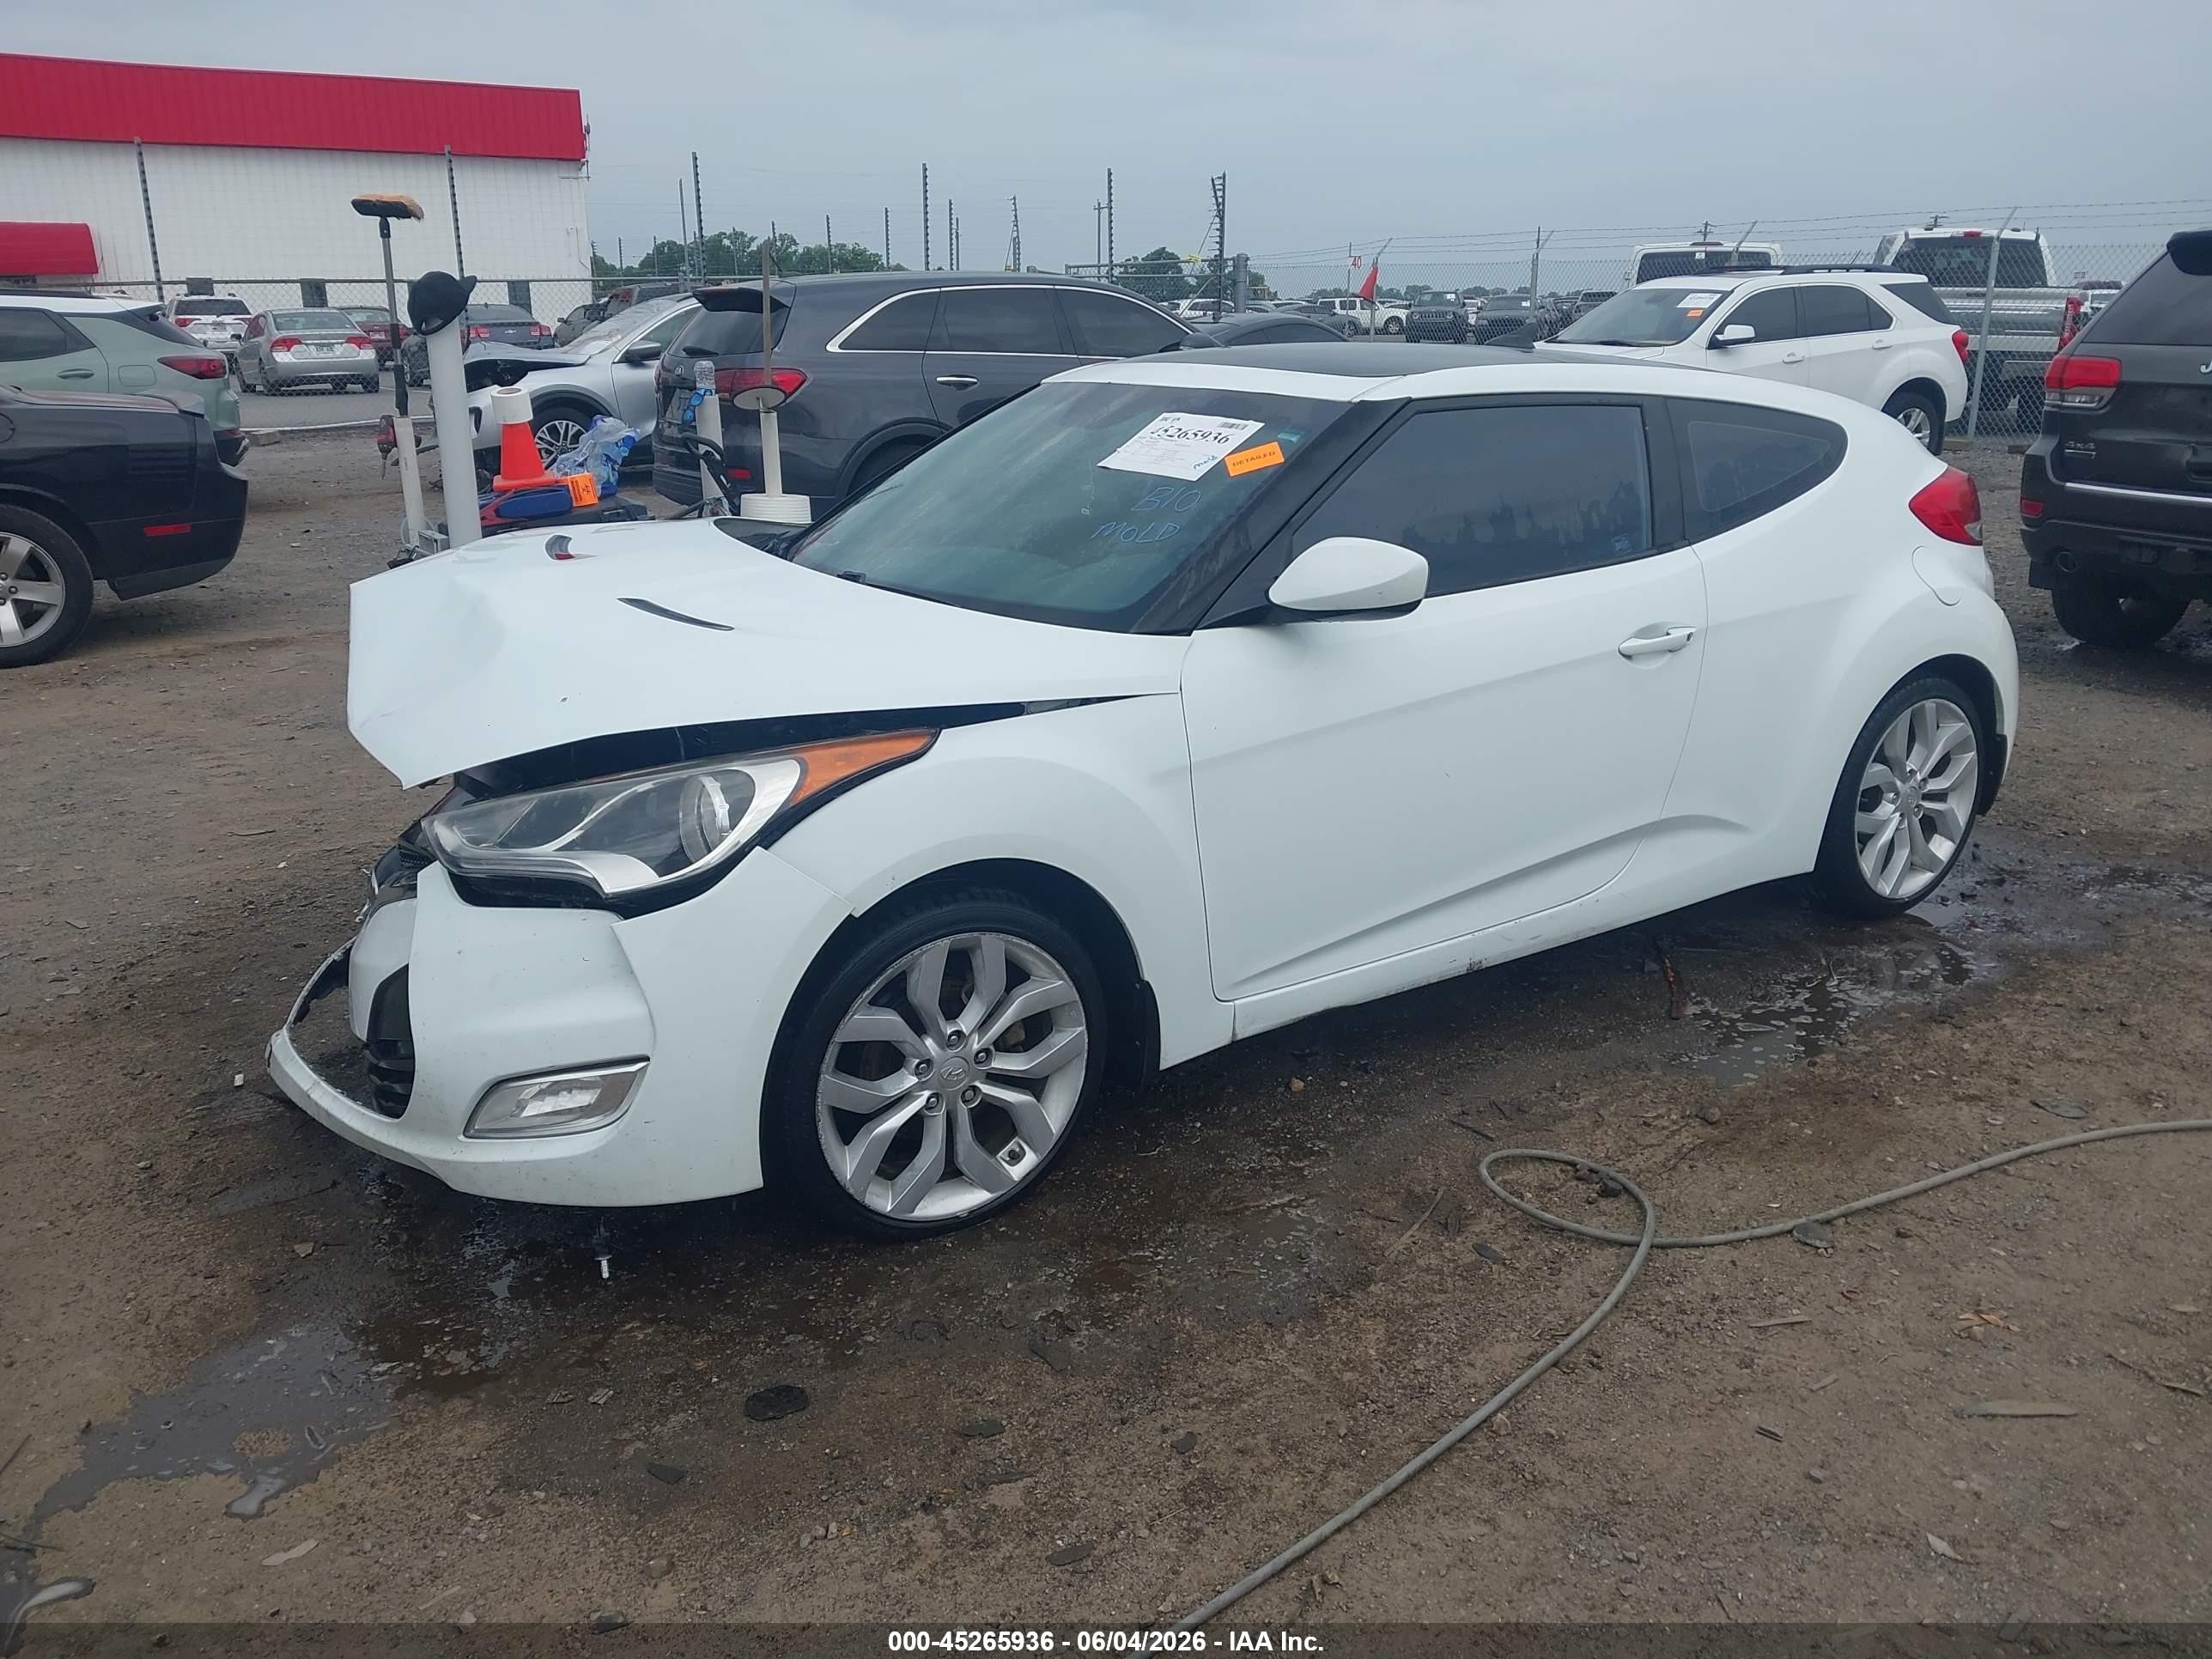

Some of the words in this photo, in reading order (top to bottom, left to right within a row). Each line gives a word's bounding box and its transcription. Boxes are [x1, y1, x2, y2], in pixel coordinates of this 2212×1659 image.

[1232, 450, 1276, 467] DETAILED
[1130, 486, 1202, 512] BIO
[1090, 521, 1181, 544] MOLD
